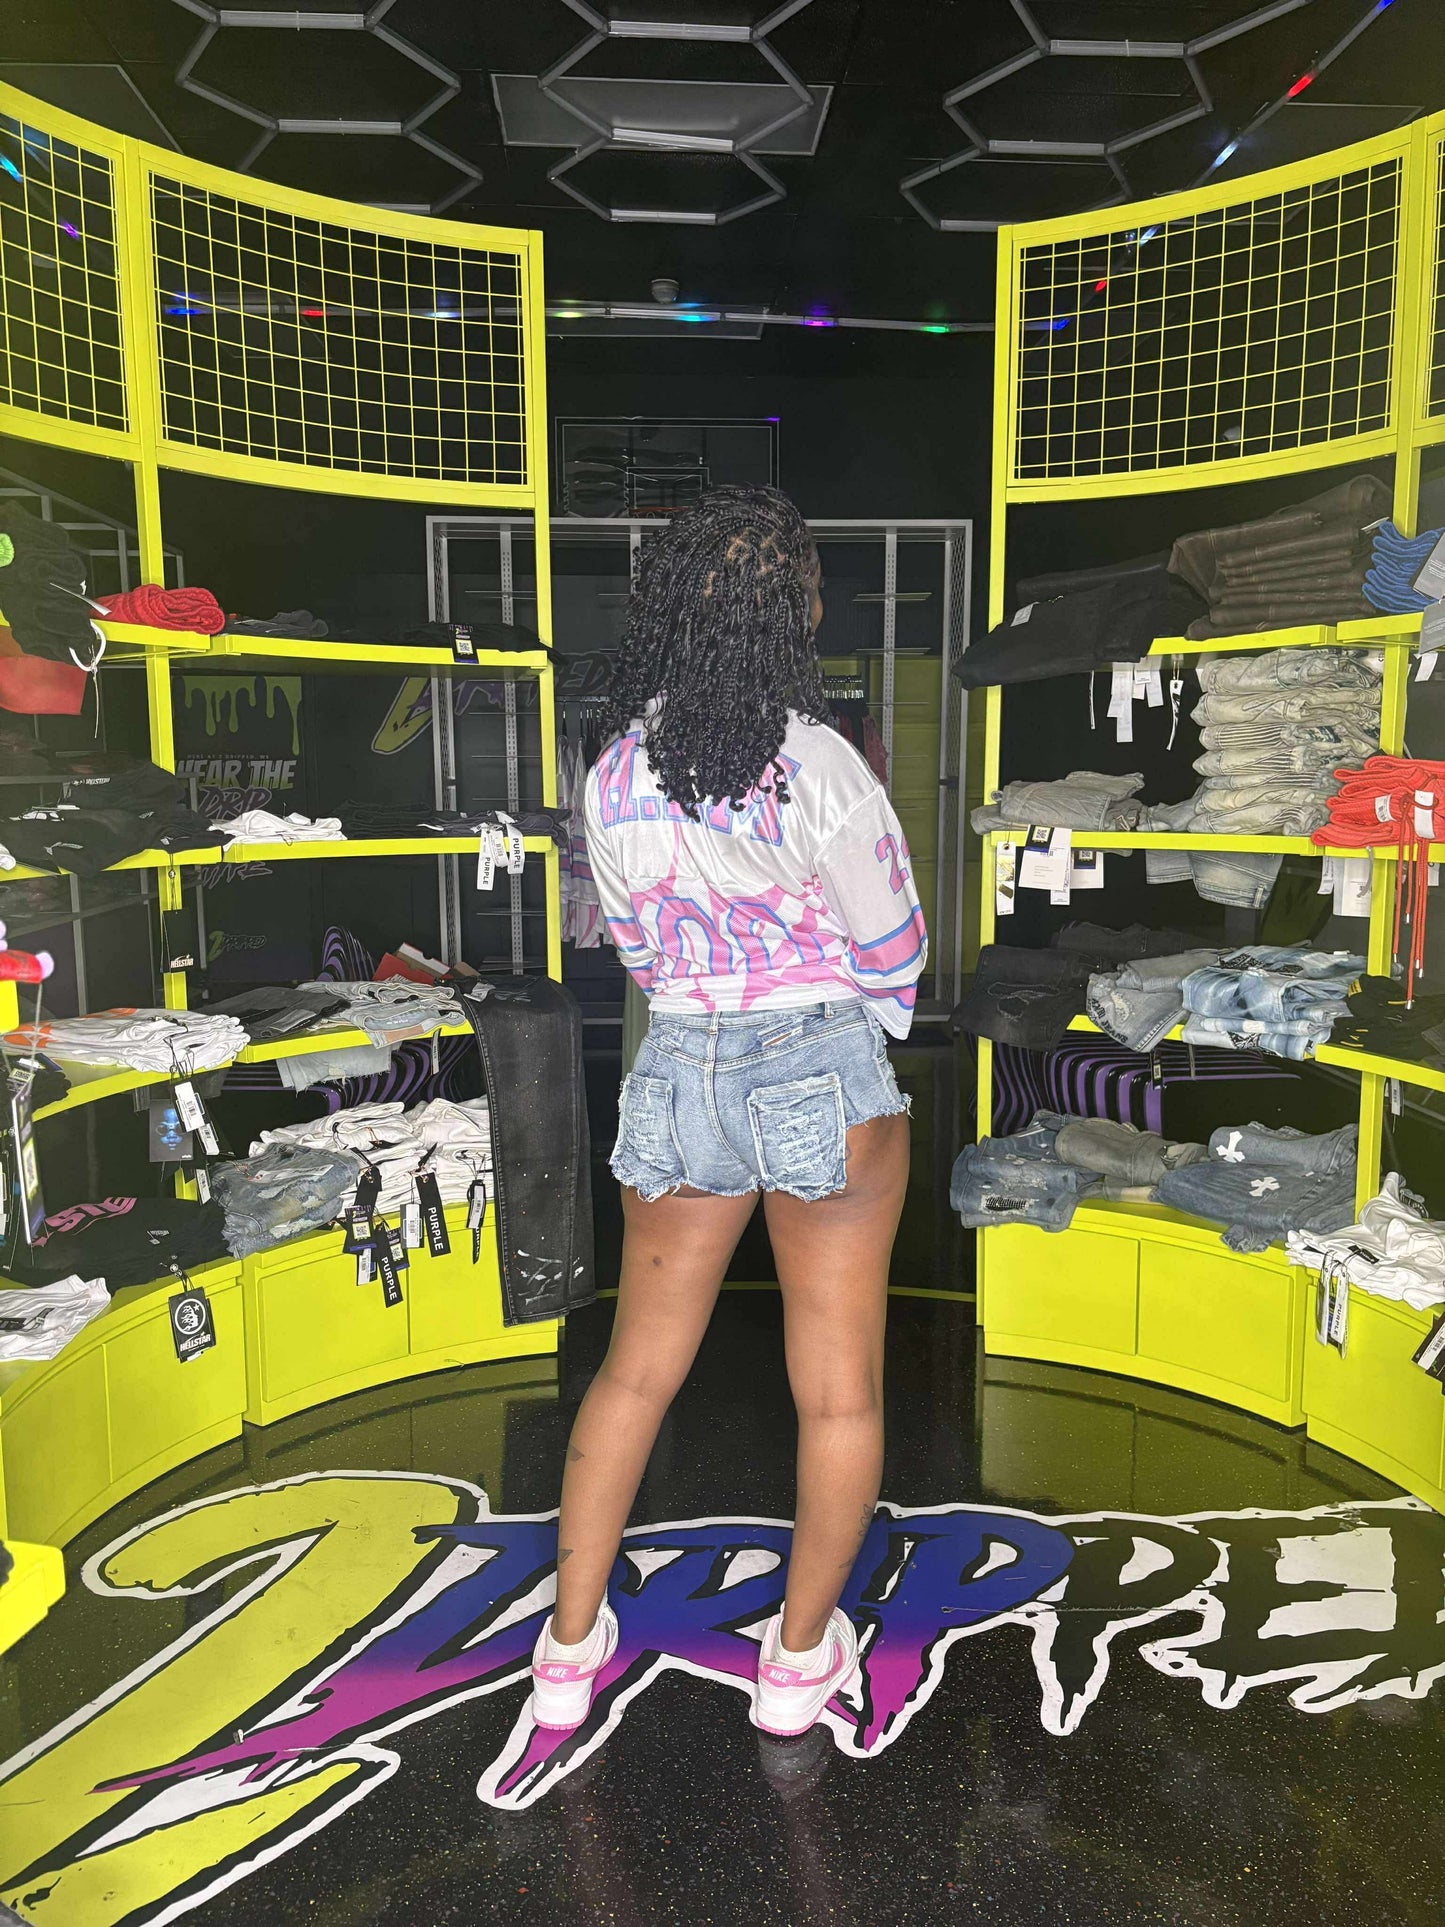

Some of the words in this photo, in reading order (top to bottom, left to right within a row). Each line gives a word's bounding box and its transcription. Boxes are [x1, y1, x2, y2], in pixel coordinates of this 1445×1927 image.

[247, 760, 297, 790] THE
[513, 838, 521, 869] PURPLE
[482, 857, 490, 885] PURPLE
[428, 1207, 444, 1251] PURPLE
[381, 1256, 398, 1301] PURPLE
[1333, 1303, 1343, 1336] PURPLE
[180, 1333, 211, 1352] HELLSTAR
[546, 1666, 568, 1679] NIKE
[768, 1668, 791, 1683] NIKE
